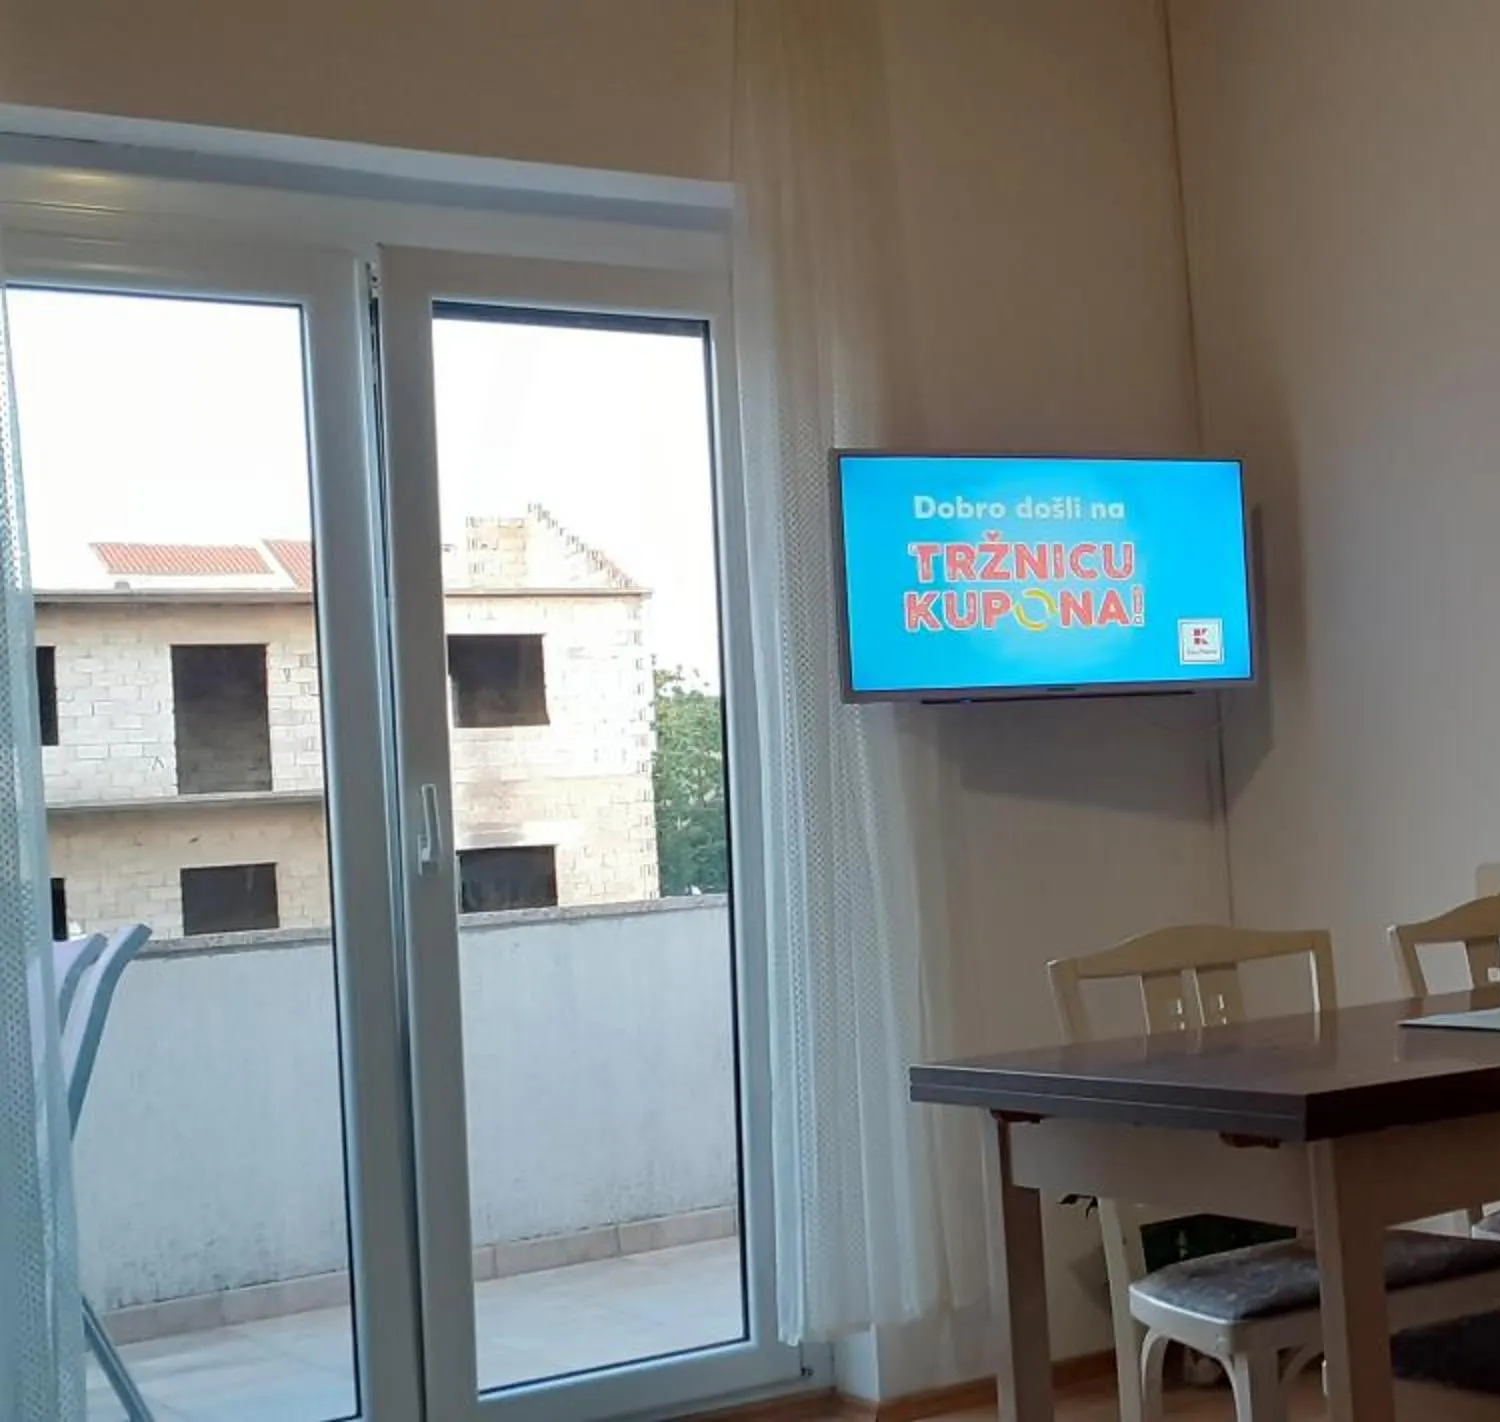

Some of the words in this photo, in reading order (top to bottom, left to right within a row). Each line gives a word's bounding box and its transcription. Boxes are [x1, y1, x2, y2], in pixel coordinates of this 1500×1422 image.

[914, 495, 1007, 519] Dobro
[1016, 495, 1082, 519] došli
[1091, 501, 1125, 519] na
[907, 530, 1135, 582] TRŽNICU
